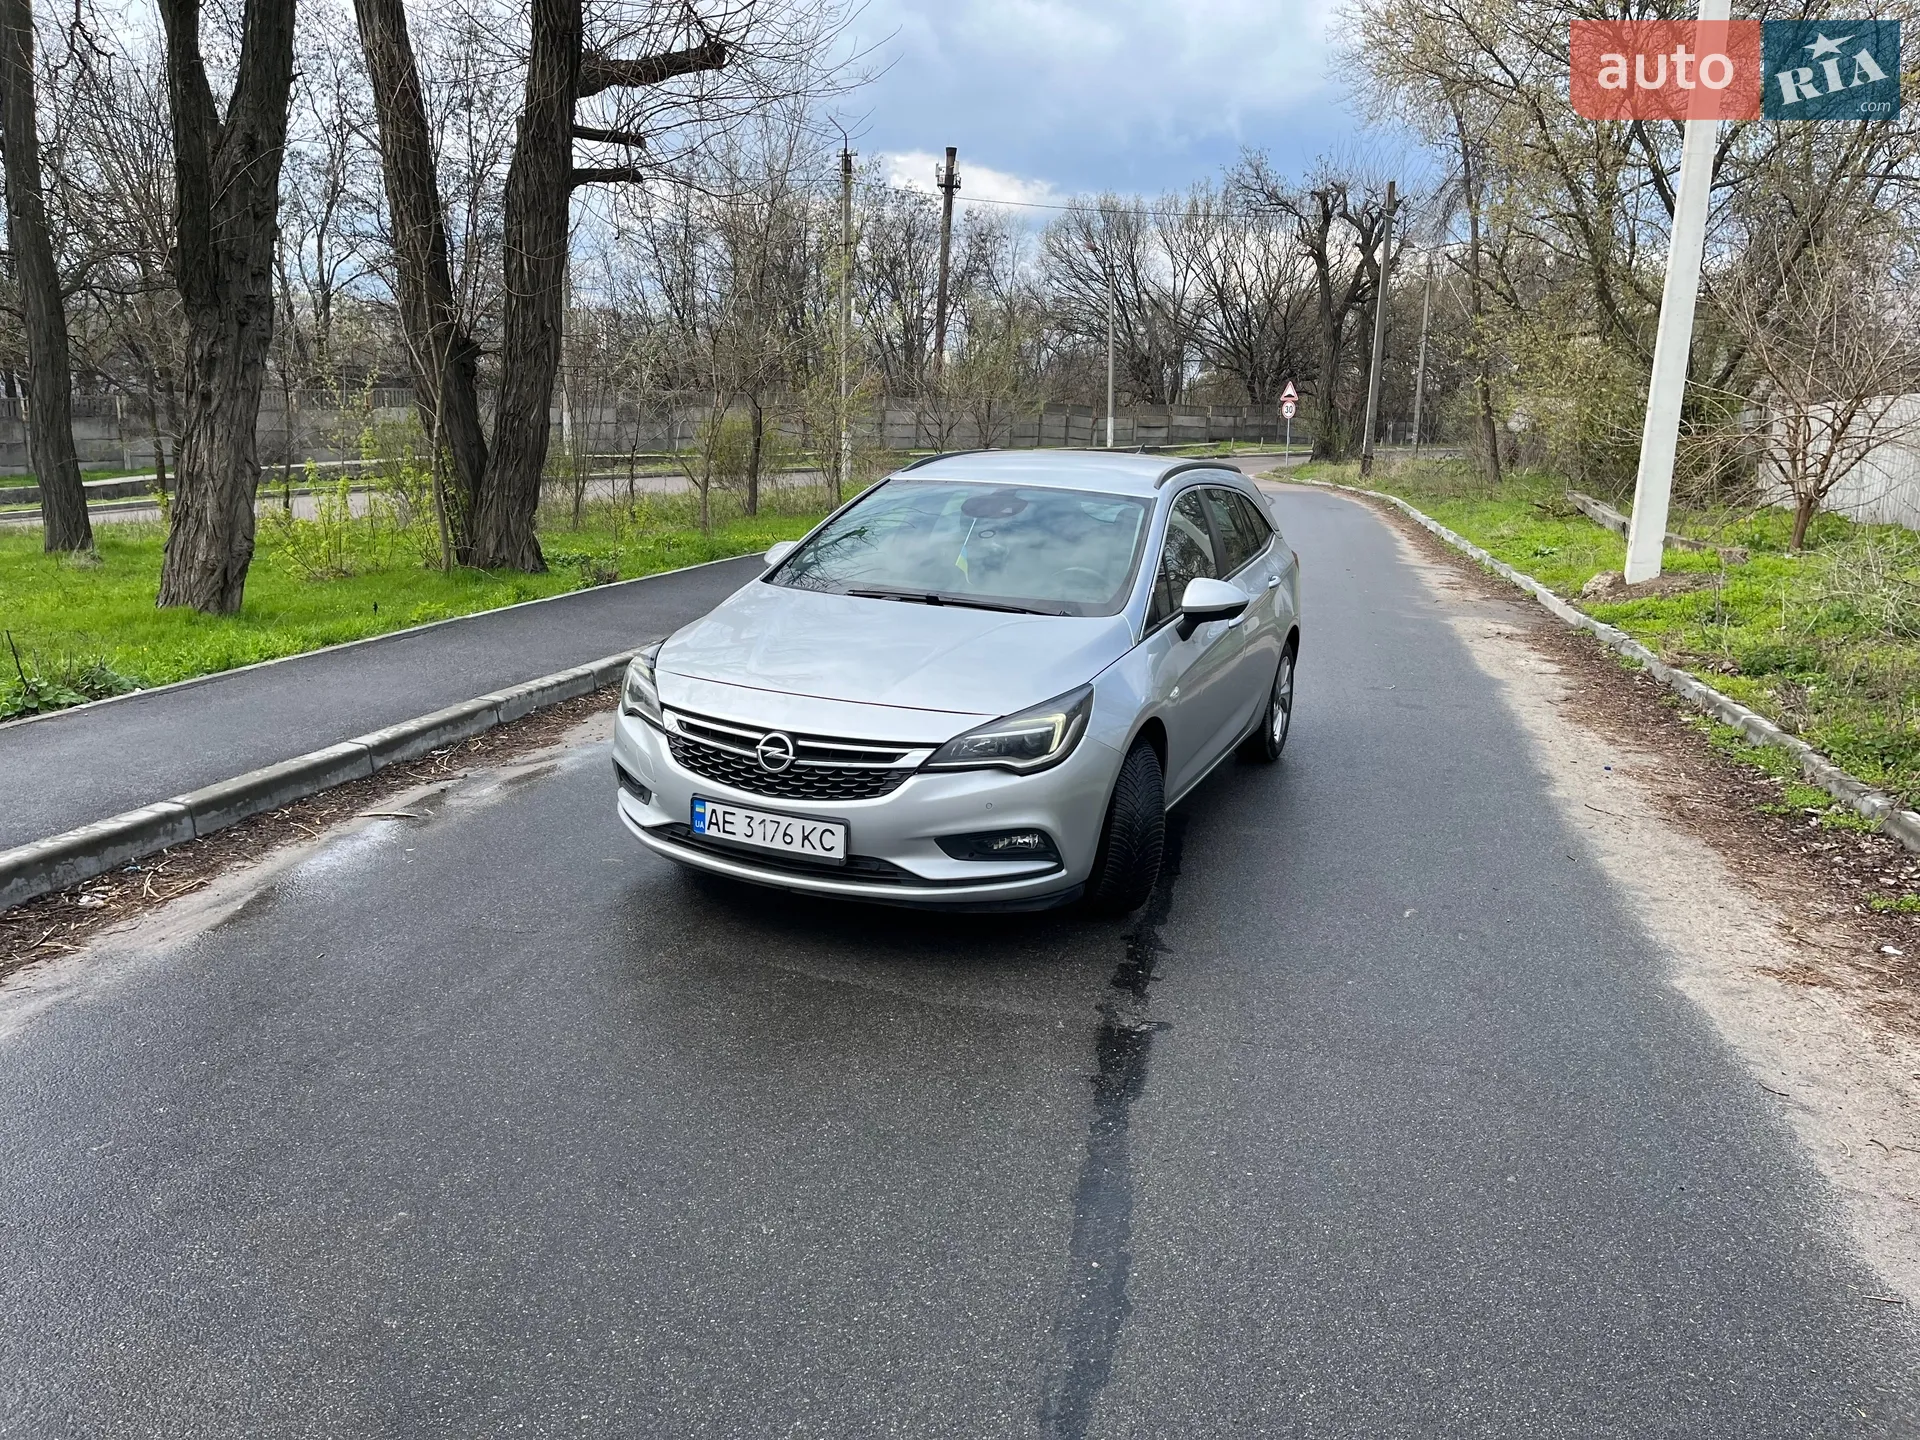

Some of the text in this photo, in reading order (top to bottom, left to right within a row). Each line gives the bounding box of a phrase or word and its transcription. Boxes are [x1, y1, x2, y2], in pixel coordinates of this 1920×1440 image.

[1285, 406, 1293, 414] 30
[695, 820, 704, 828] UA
[707, 808, 836, 851] AE 3176 KC
